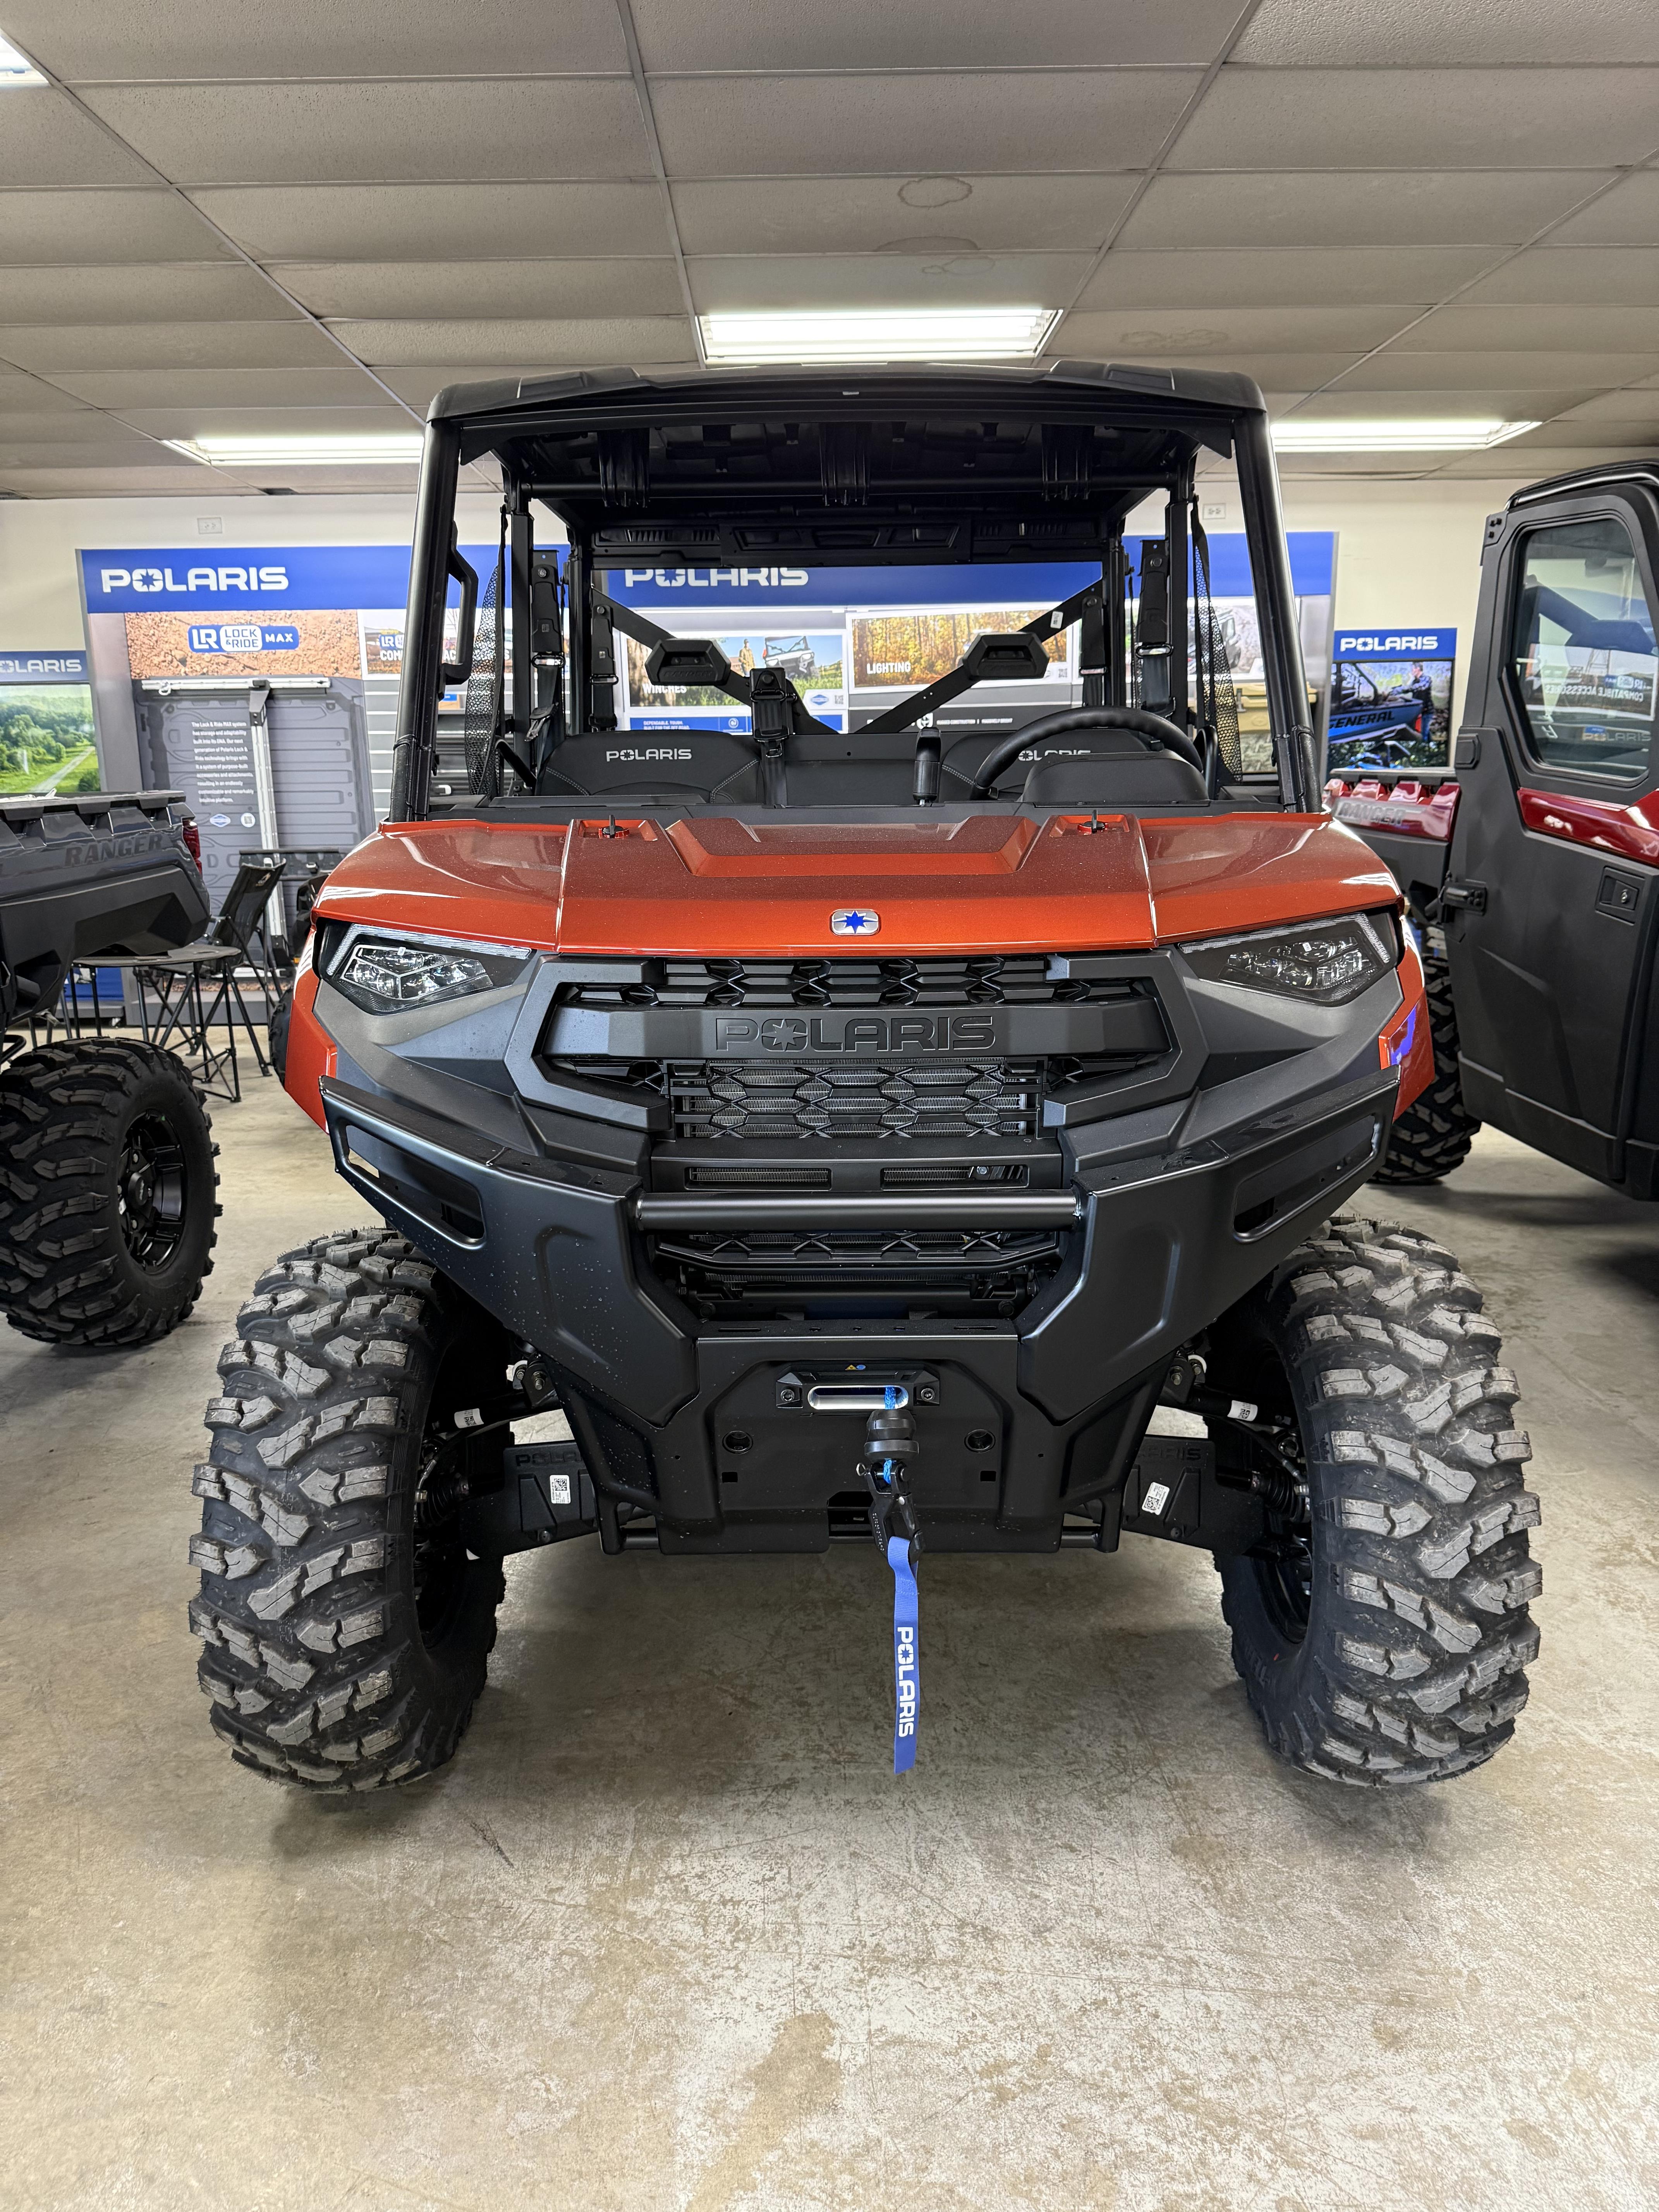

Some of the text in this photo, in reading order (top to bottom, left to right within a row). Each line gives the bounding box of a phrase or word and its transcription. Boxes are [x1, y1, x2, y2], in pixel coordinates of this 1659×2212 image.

[101, 567, 289, 592] POLARIS
[625, 568, 809, 587] POLARIS
[225, 629, 257, 638] LOCK
[265, 634, 294, 642] MAX
[1340, 636, 1438, 652] POLARIS
[0, 659, 82, 673] OLARIS
[867, 661, 911, 674] LIGHTING
[642, 684, 687, 694] WINCHES
[606, 749, 692, 762] POLARIS
[64, 833, 163, 866] RANGER
[716, 1016, 995, 1052] POLARIS
[897, 1626, 915, 1737] POLARIS
